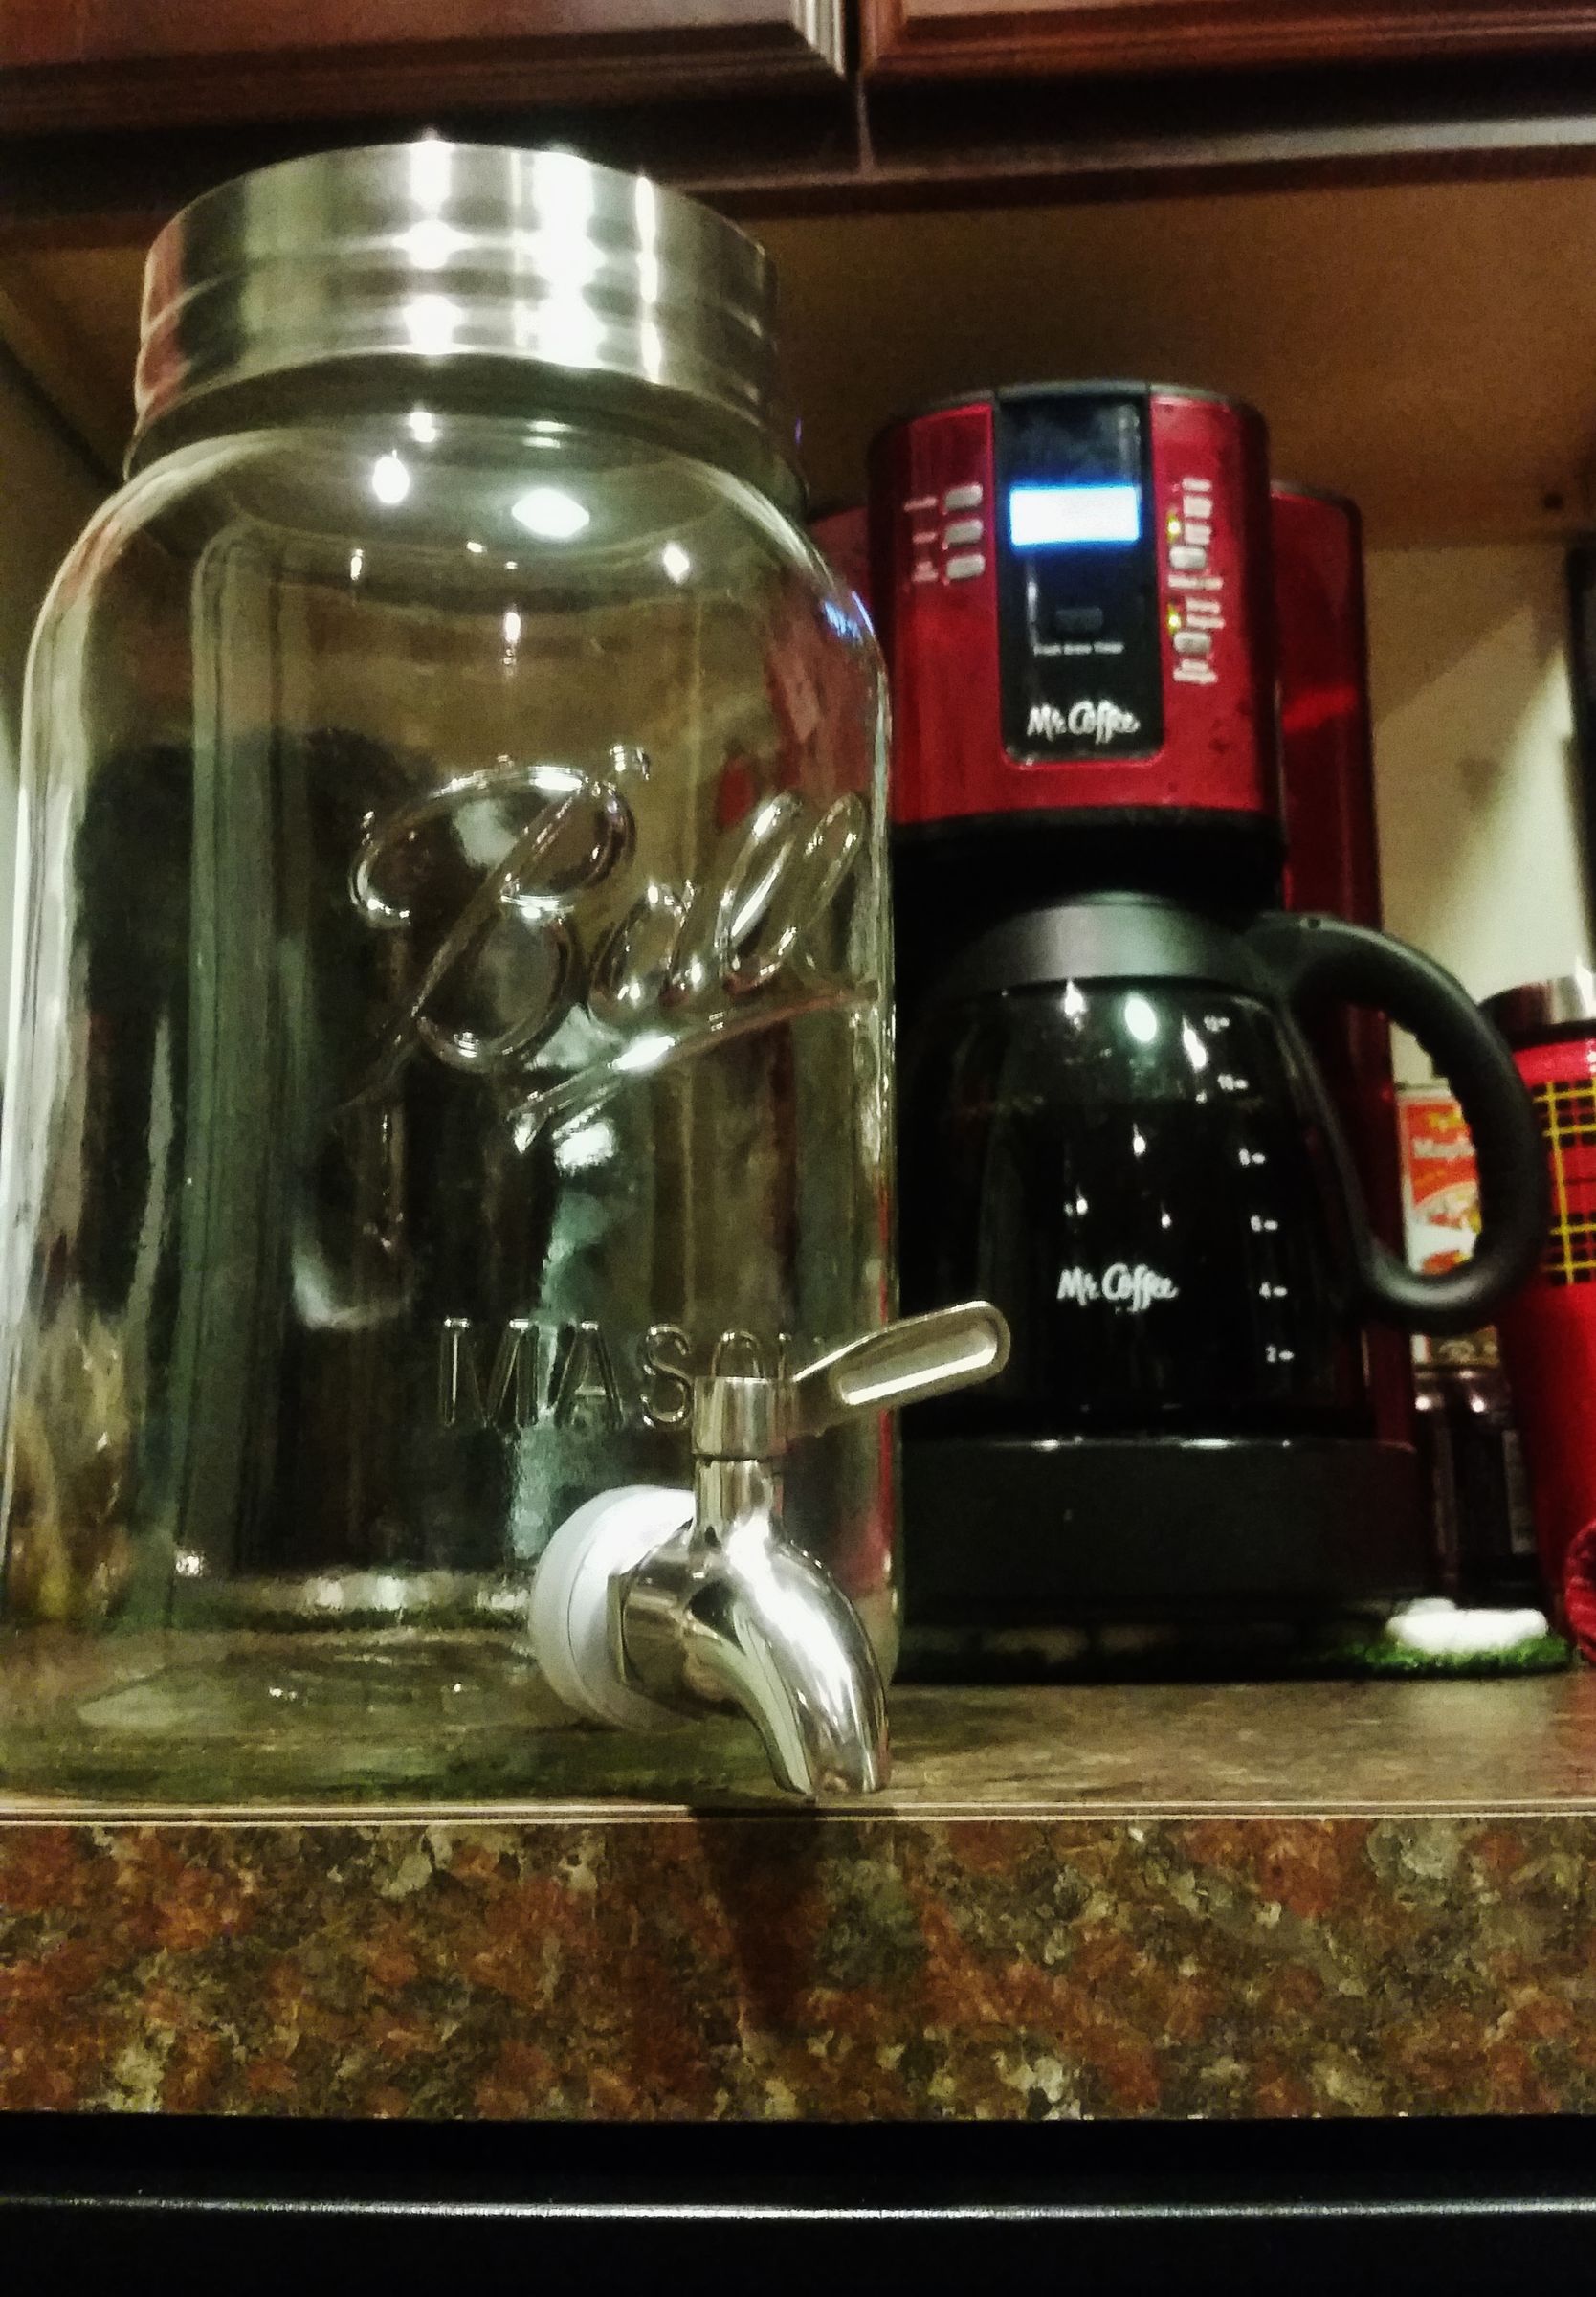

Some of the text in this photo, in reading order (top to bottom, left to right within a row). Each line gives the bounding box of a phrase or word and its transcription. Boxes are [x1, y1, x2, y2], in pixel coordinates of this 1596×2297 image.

[1068, 700, 1140, 745] Coffee
[343, 747, 866, 1086] Ball
[1101, 1263, 1179, 1312] Coffee
